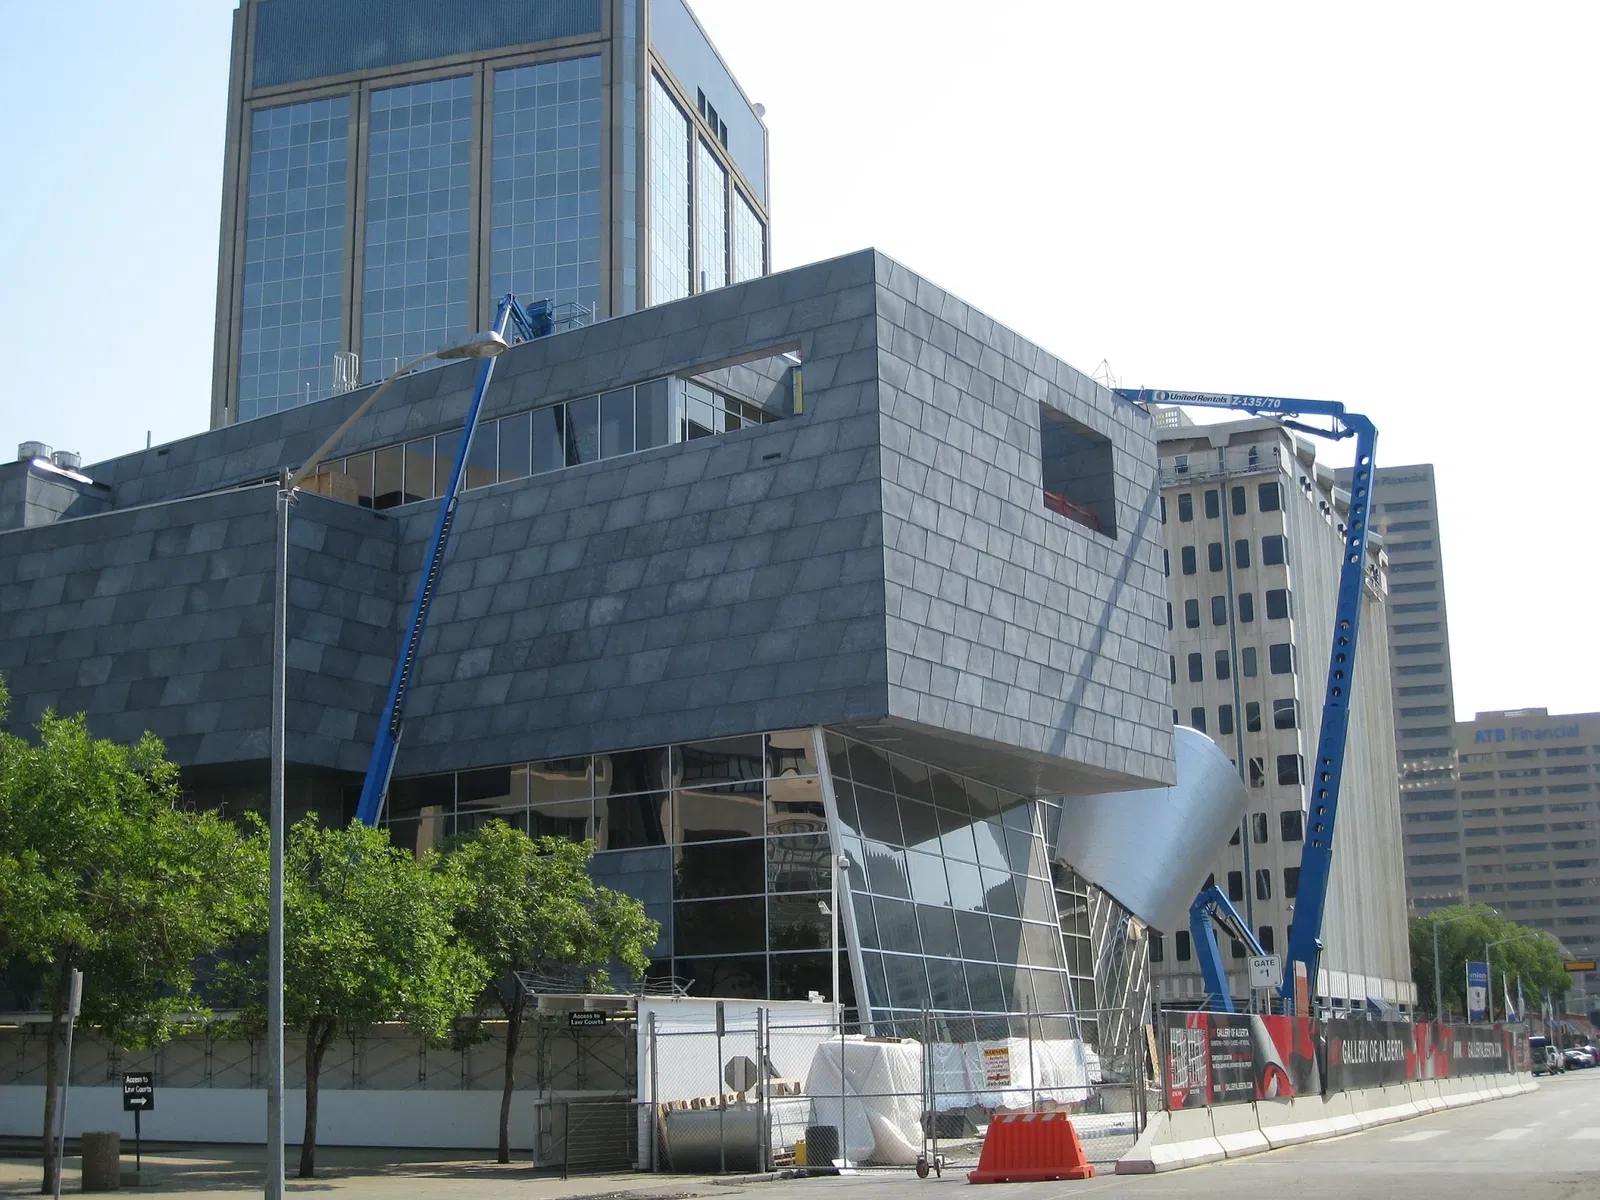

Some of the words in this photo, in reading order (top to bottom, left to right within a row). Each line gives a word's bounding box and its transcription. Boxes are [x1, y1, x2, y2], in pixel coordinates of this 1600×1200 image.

[1170, 393, 1197, 402] United
[1197, 395, 1228, 404] Rentals
[1232, 396, 1281, 408] Z-135/70
[1474, 728, 1506, 744] ATB
[1511, 723, 1580, 741] Financial
[1342, 1039, 1369, 1064] GALLERY
[1369, 1039, 1378, 1063] OF
[1379, 1039, 1405, 1062] ALBERTA
[126, 1075, 142, 1083] Access
[124, 1085, 135, 1093] Law
[135, 1085, 152, 1093] Courts
